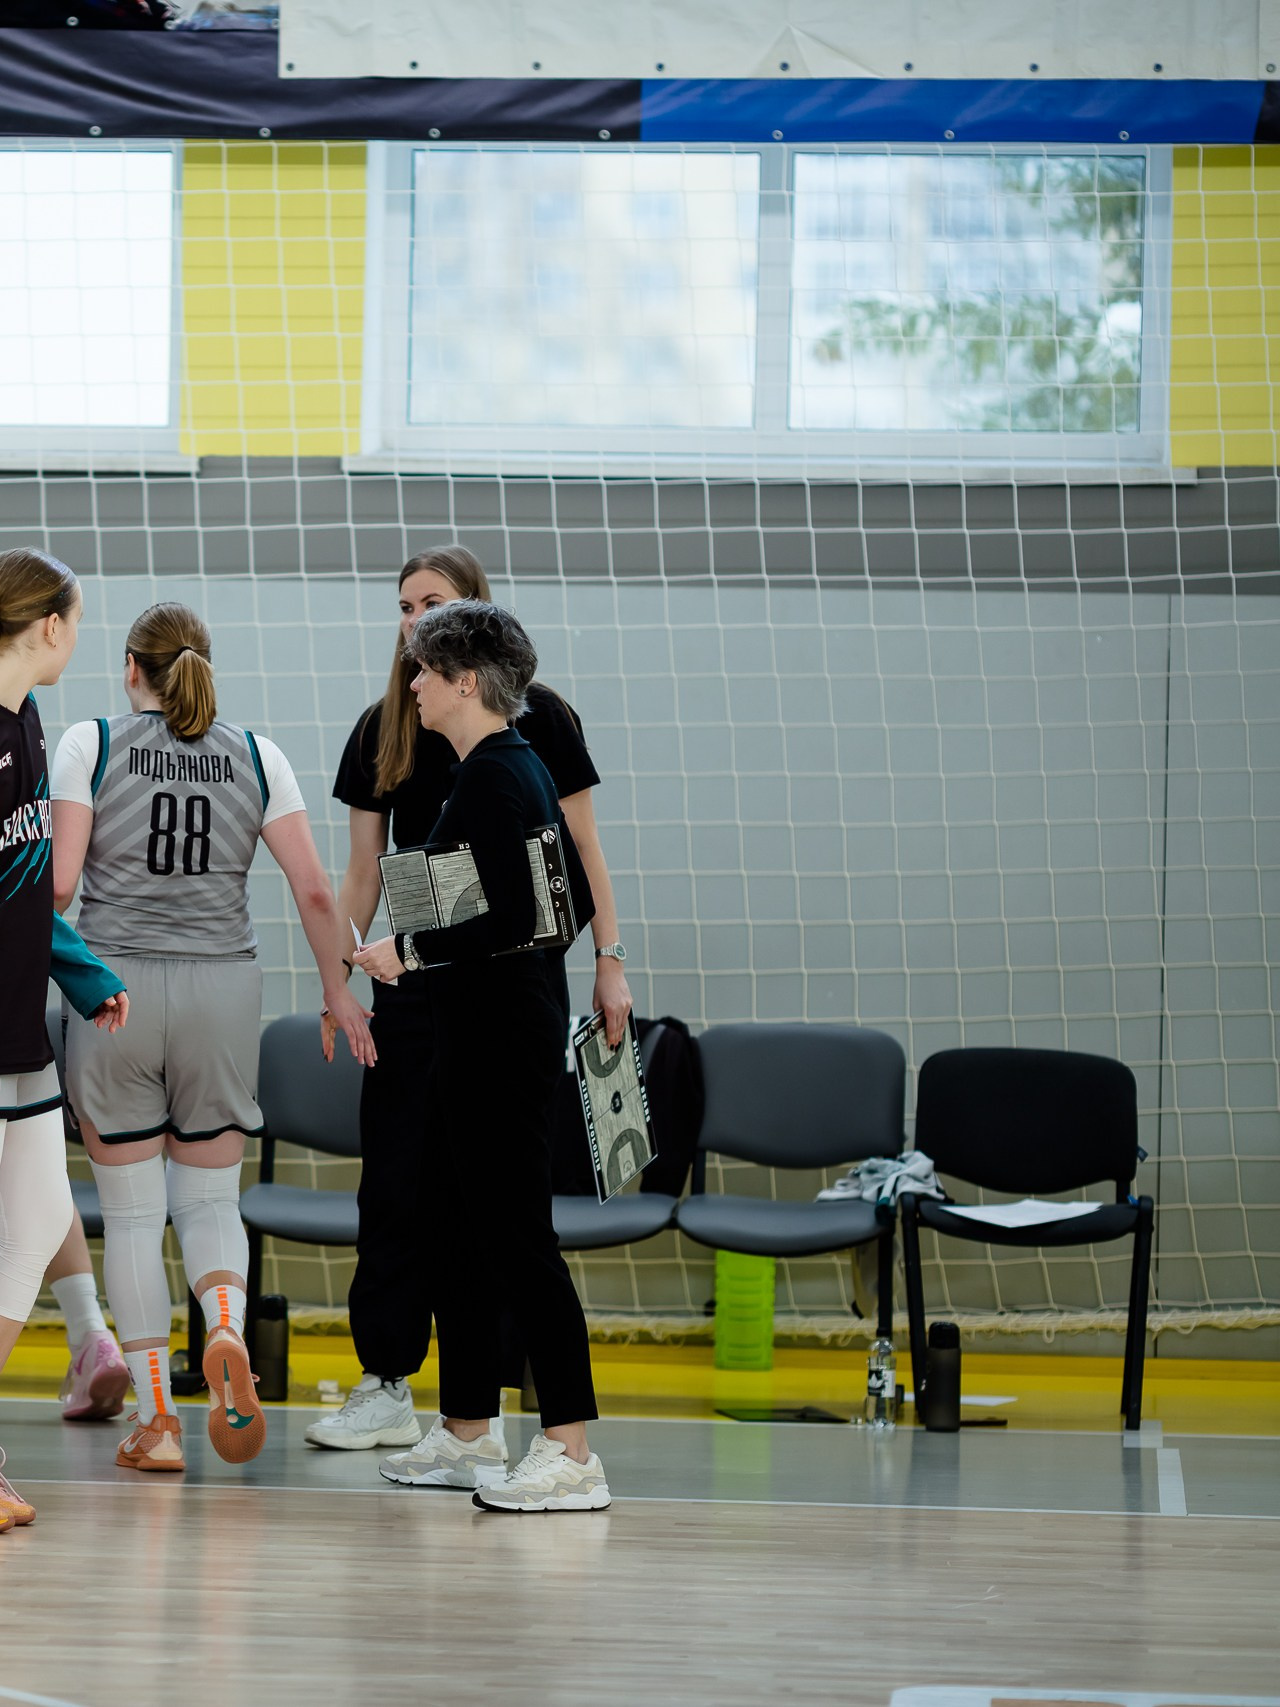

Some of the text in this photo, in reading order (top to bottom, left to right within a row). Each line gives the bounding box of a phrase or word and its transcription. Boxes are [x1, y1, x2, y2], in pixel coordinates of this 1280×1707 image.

[129, 747, 235, 783] ПОДЪЯНОВА
[147, 791, 211, 876] 88
[632, 1040, 651, 1123] BLACK BEARS
[588, 1123, 601, 1172] VOLODIN
